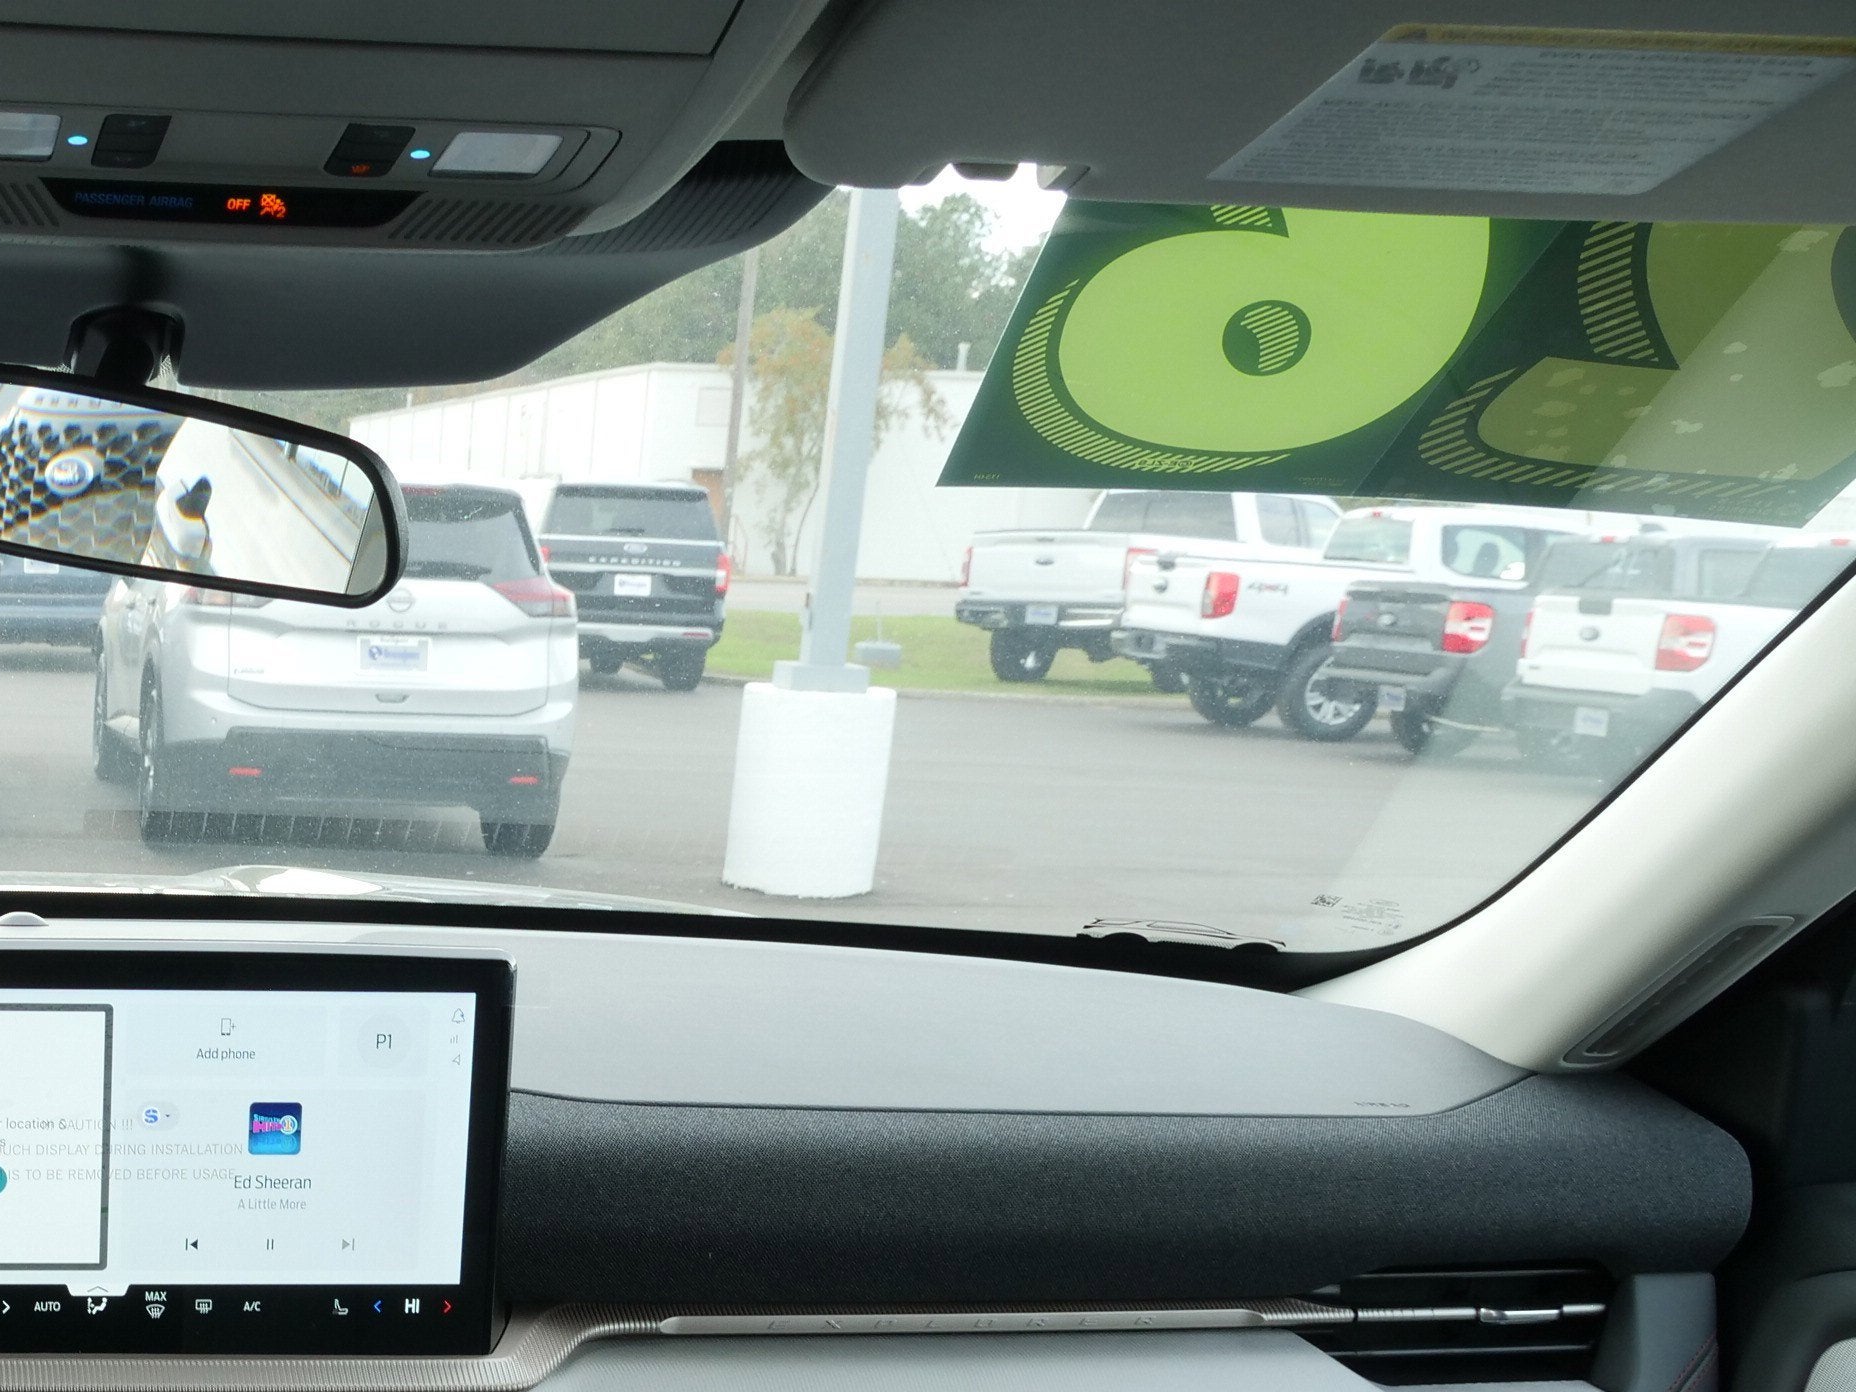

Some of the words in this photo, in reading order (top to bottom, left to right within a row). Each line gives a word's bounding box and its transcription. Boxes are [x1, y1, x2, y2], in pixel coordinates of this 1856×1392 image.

[73, 191, 145, 207] PASSENGER
[149, 195, 195, 209] AIRBAG
[227, 198, 251, 211] OFF
[588, 555, 682, 567] EXPEDITION
[375, 1033, 393, 1050] P1
[196, 1047, 217, 1060] Add
[220, 1047, 256, 1063] phone
[6, 1117, 54, 1130] location
[36, 1144, 90, 1156] DISPLAY
[95, 1144, 145, 1155] DRING
[151, 1143, 243, 1155] INSTALLATION
[9, 1169, 20, 1181] IS
[25, 1169, 42, 1181] TO
[46, 1169, 64, 1180] BE
[137, 1169, 187, 1180] BEFORE
[192, 1169, 235, 1180] USAGE
[234, 1175, 251, 1190] Ed
[254, 1174, 312, 1190] Sheeran
[238, 1199, 246, 1210] A
[248, 1198, 276, 1210] Little
[278, 1199, 307, 1210] More
[145, 1291, 167, 1302] MAX
[33, 1301, 62, 1313] AUTO
[243, 1300, 261, 1313] A/C
[404, 1298, 420, 1315] HI
